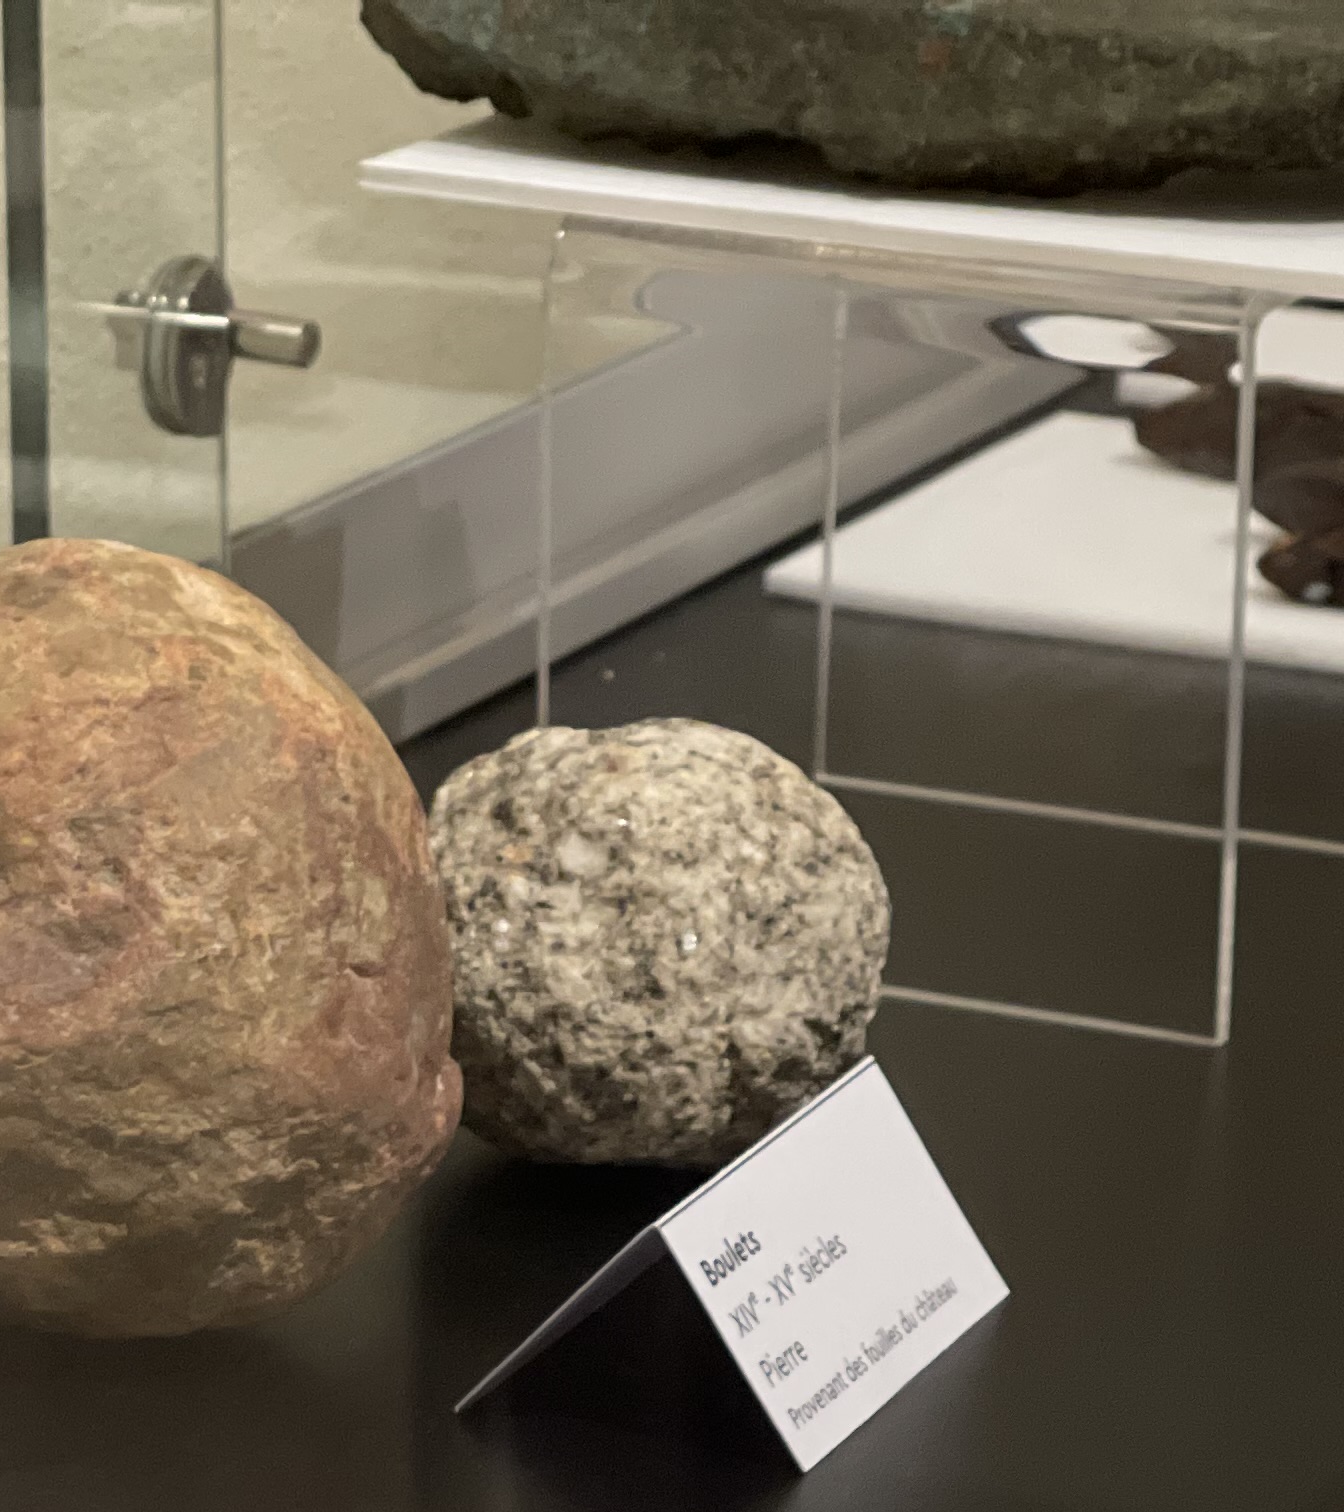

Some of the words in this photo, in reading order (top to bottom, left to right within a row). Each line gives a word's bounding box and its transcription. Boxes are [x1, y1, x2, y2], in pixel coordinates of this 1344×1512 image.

[698, 1230, 761, 1287] Boulets
[797, 1234, 847, 1284] siècles
[758, 1340, 808, 1387] Pierre
[786, 1371, 849, 1429] Provenant
[843, 1355, 869, 1382] des
